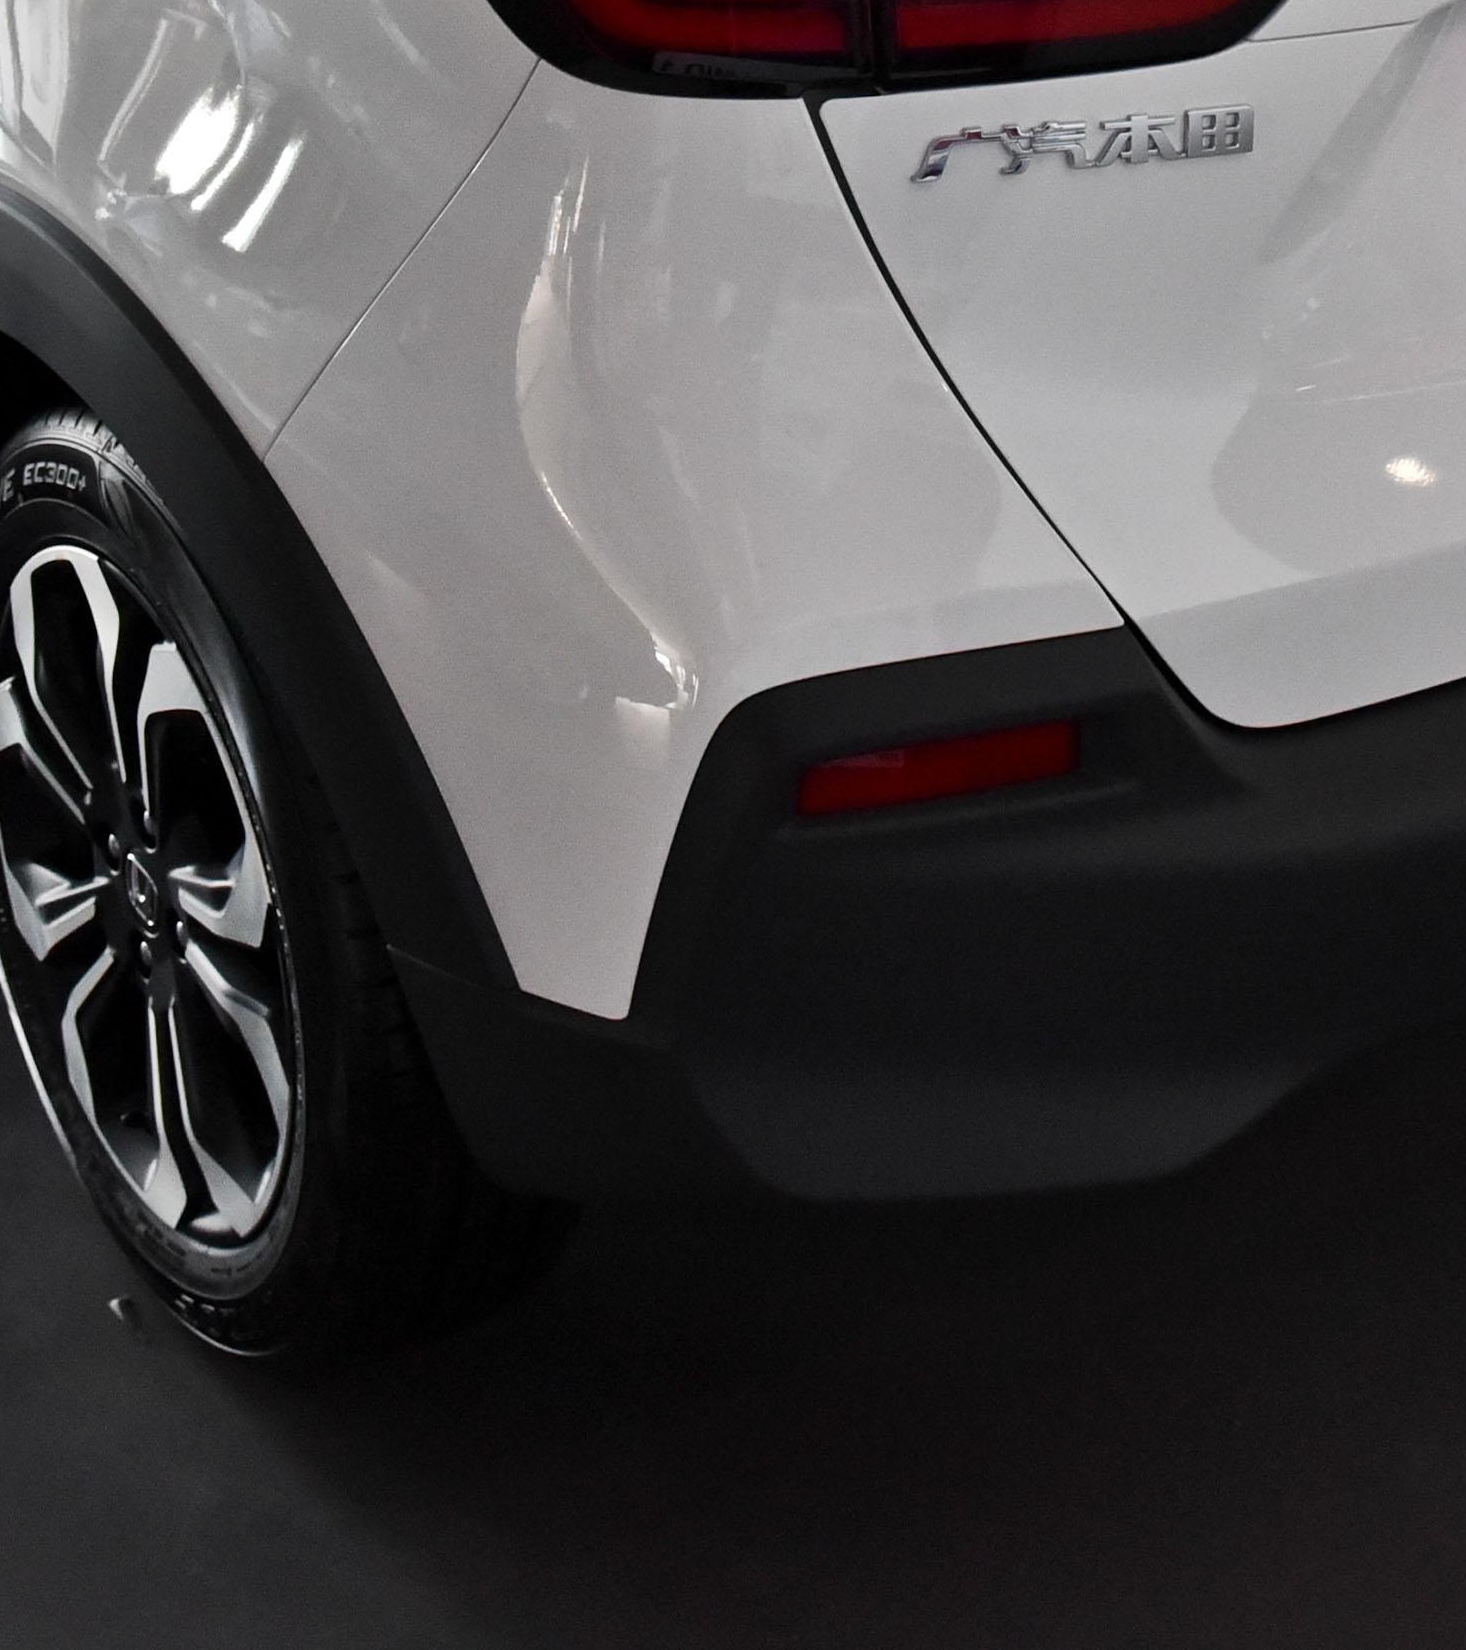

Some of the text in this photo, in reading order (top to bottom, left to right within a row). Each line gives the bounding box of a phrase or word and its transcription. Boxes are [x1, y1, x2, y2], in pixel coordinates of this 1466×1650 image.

[910, 103, 1255, 183] 广汽本田
[22, 461, 87, 492] EC300+
